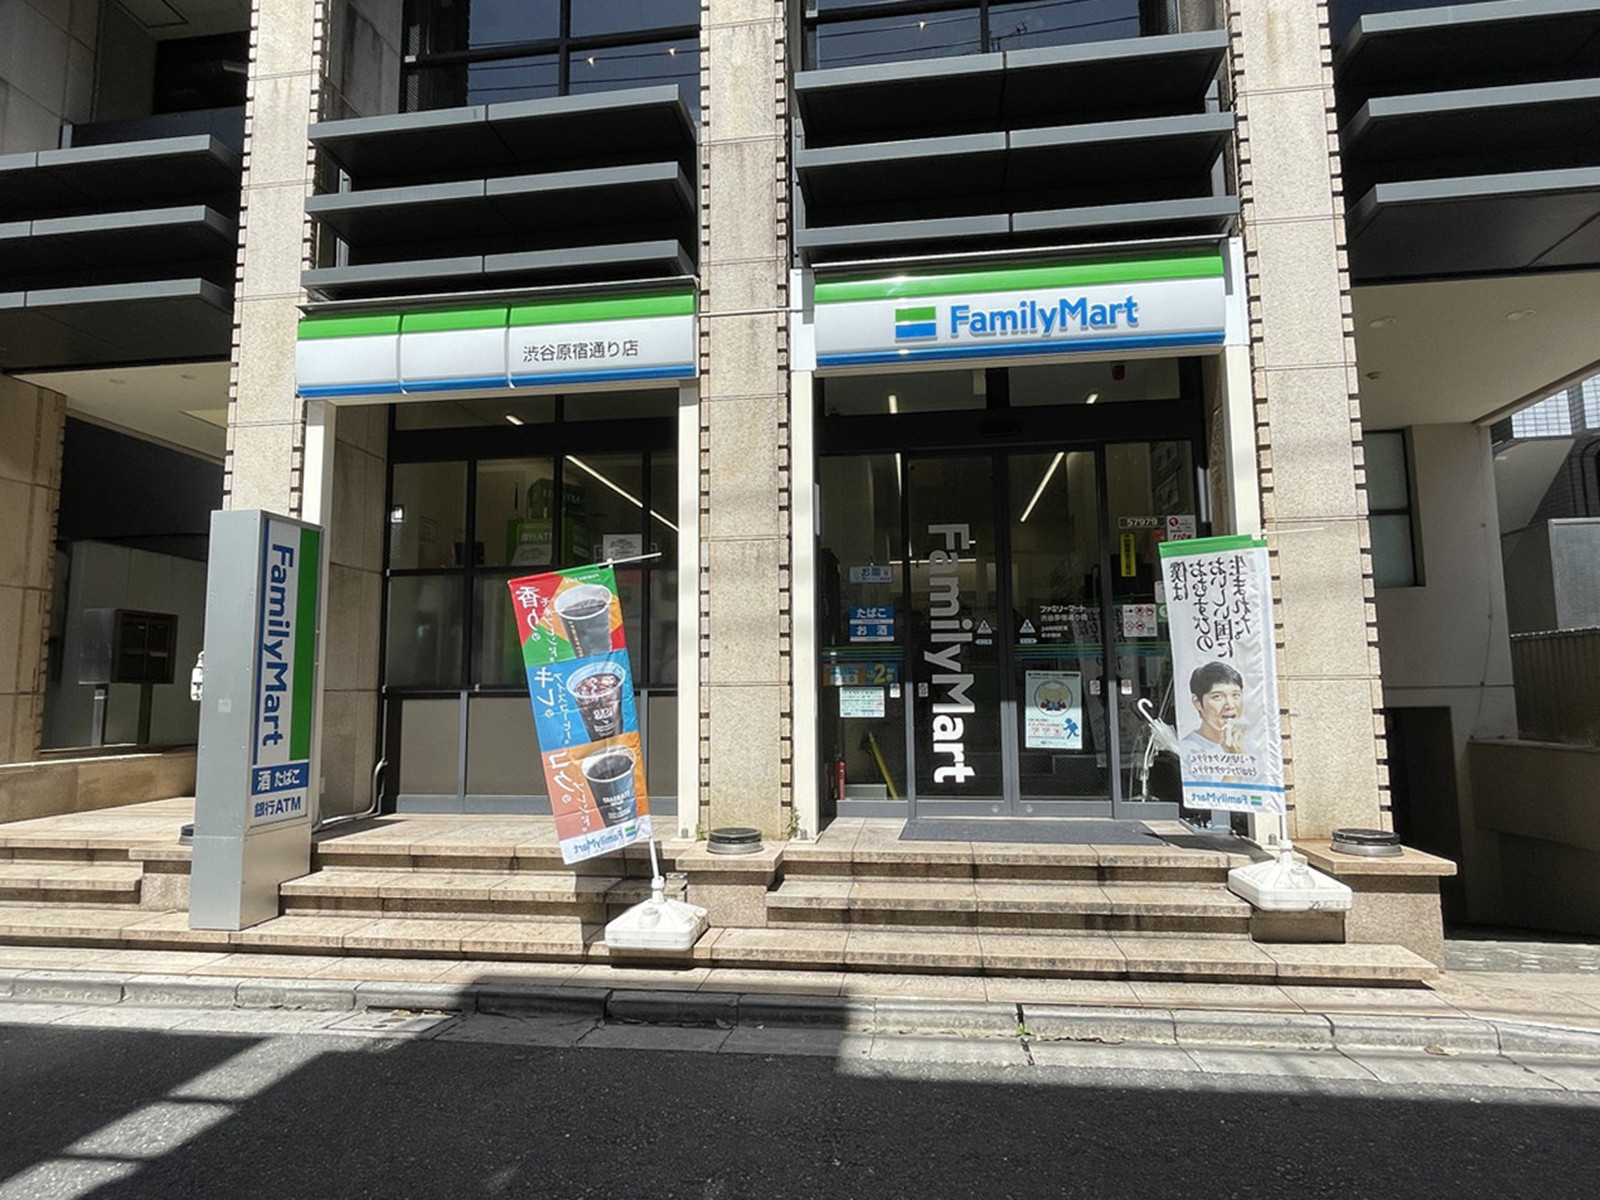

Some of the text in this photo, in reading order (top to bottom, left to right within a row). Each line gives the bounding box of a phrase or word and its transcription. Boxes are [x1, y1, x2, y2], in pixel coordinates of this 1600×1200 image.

[950, 295, 1139, 335] FamilyMart
[522, 340, 639, 362] 渋谷原宿通り店
[856, 607, 887, 619] たばこ
[1040, 604, 1086, 614] ファミリーマート
[262, 543, 294, 746] FamilyMart
[924, 523, 976, 783] FamilyMart
[257, 769, 300, 791] 酒 たばこ
[254, 795, 301, 818] 銀行ATM
